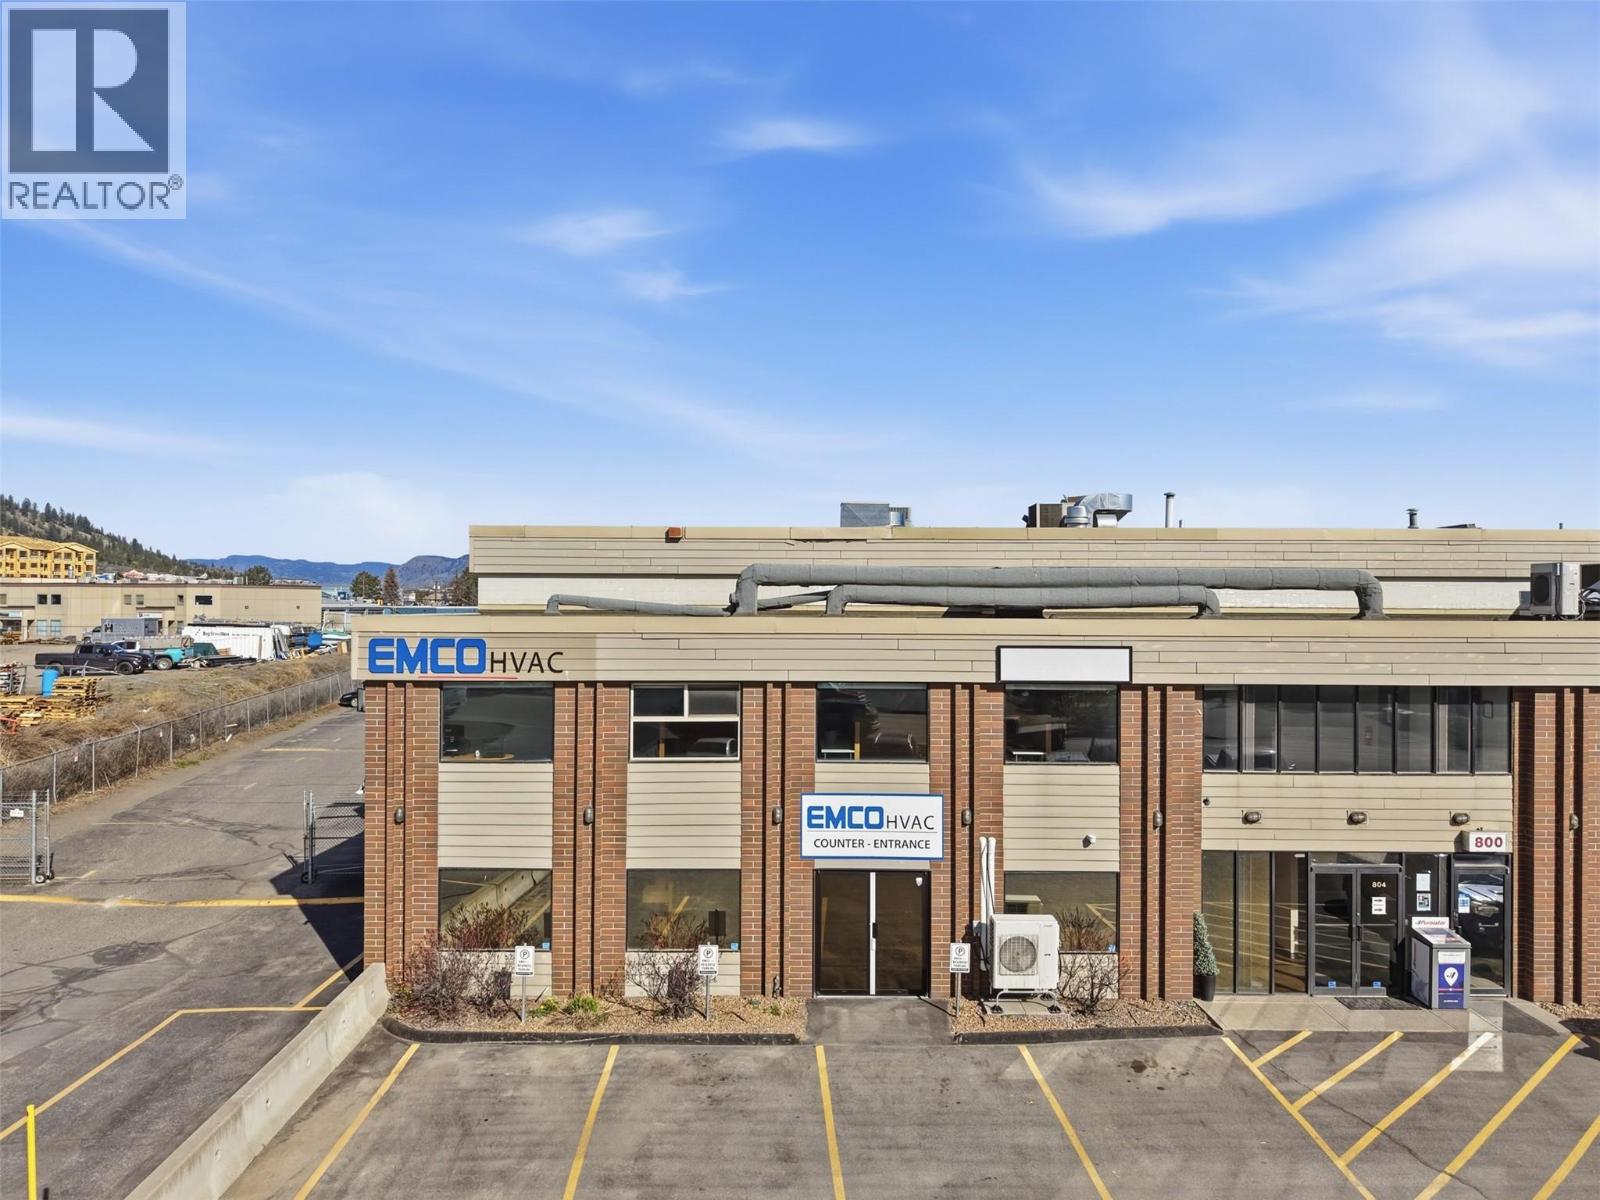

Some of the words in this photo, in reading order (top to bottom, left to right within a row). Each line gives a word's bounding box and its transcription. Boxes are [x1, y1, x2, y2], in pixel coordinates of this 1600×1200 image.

[368, 638, 487, 674] EMCO
[490, 651, 564, 673] HVAC
[806, 805, 884, 829] EMCO
[886, 815, 935, 830] HVAC
[813, 838, 865, 848] COUNTER
[873, 839, 931, 849] ENTRANCE
[1474, 836, 1504, 848] 800
